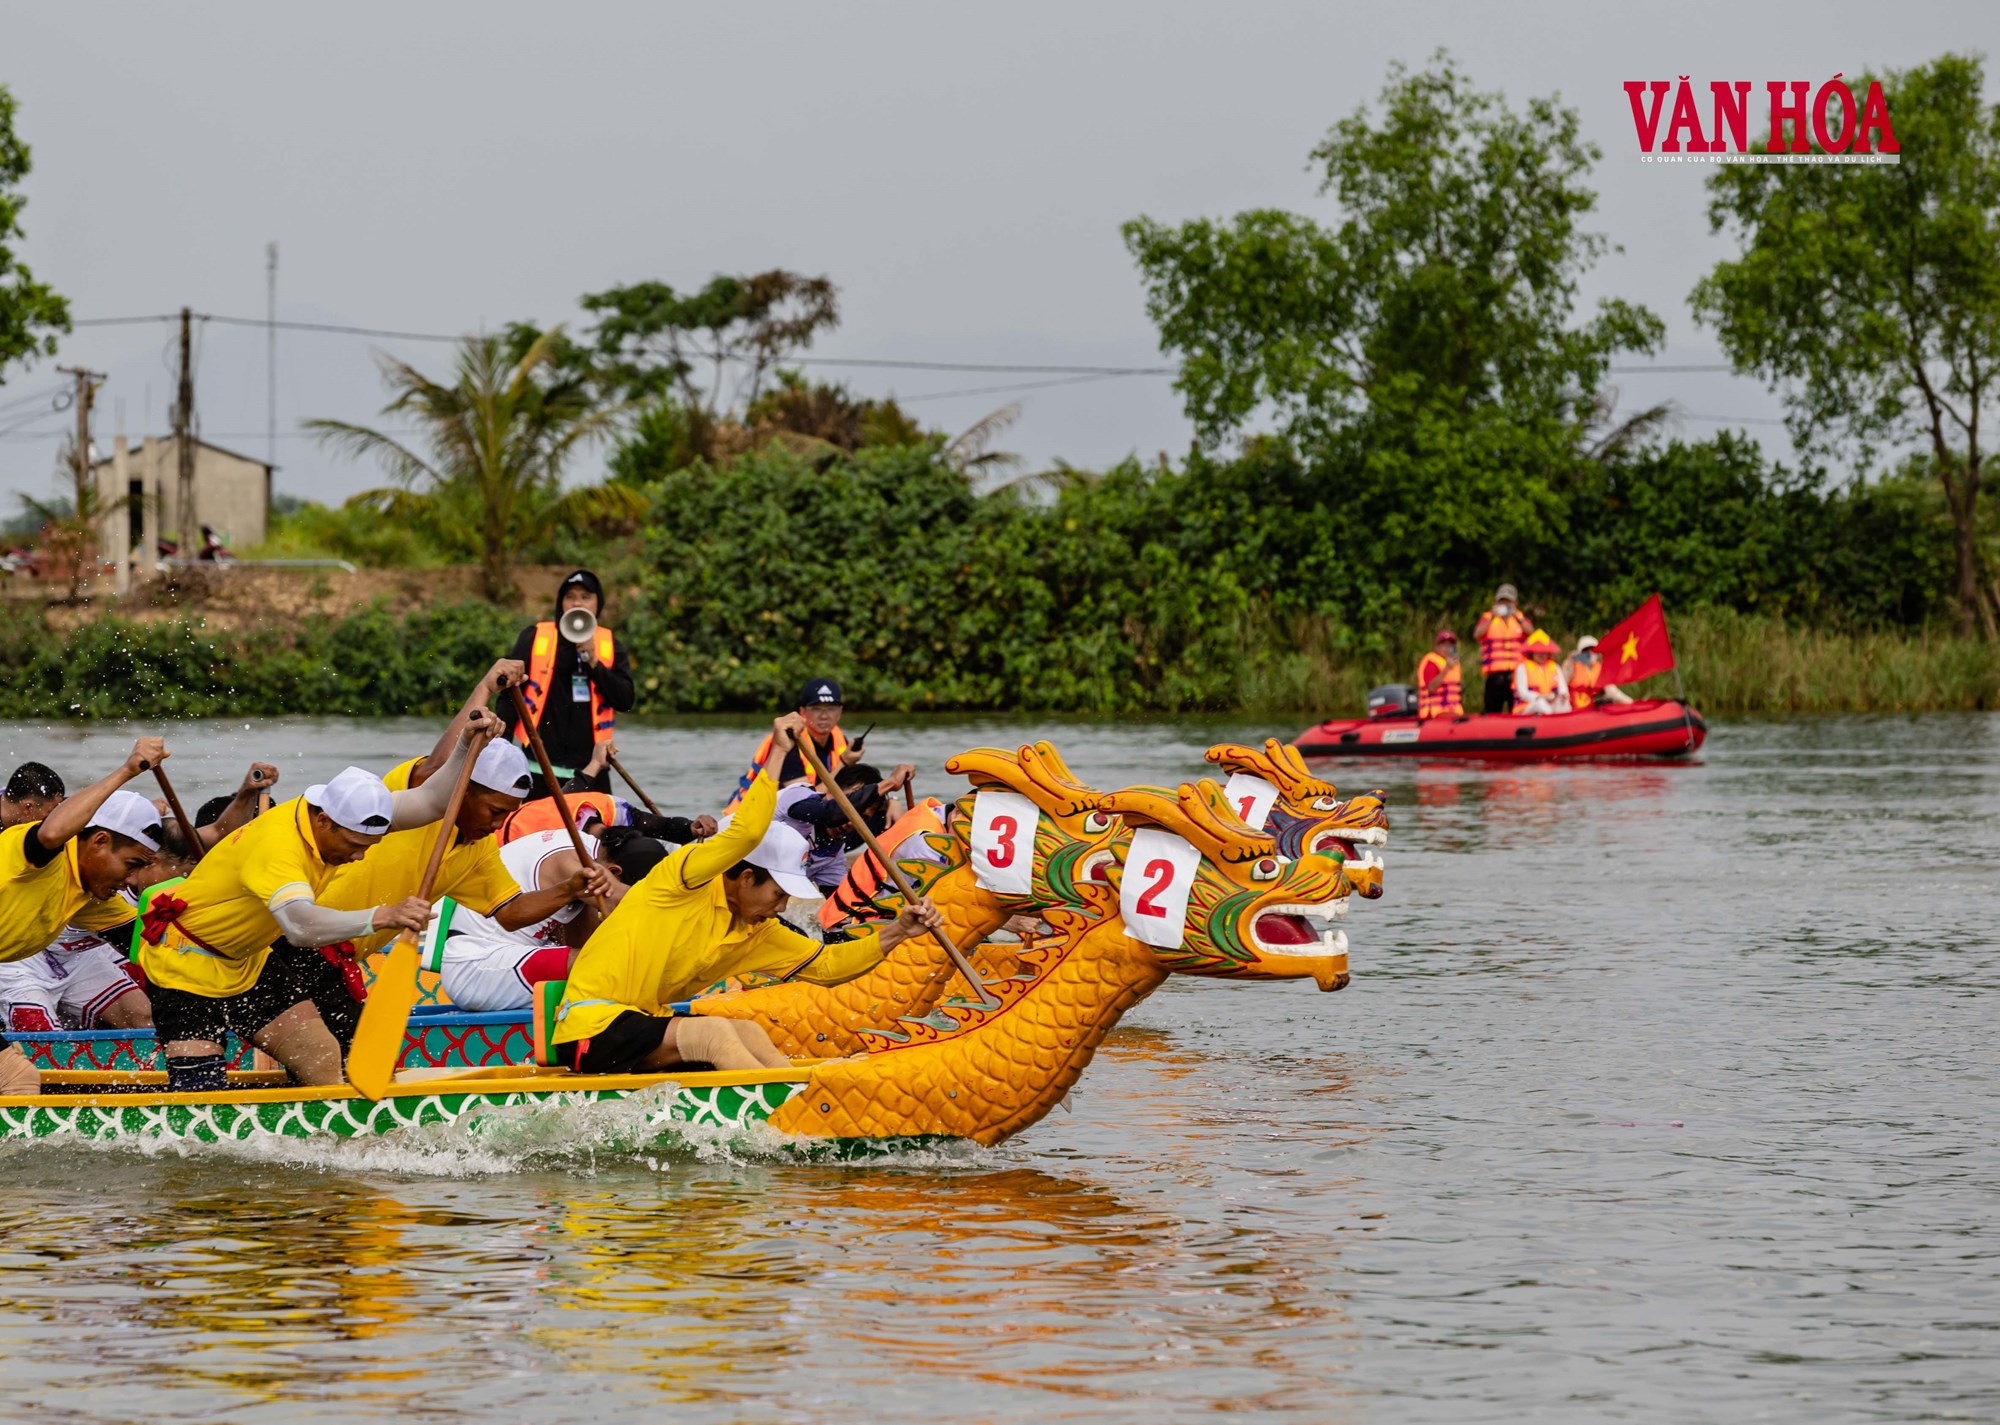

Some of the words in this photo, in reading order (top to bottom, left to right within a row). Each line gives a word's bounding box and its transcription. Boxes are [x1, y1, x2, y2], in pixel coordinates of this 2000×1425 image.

[1238, 795, 1257, 823] 1
[986, 815, 1018, 869] 3
[1135, 858, 1175, 919] 2
